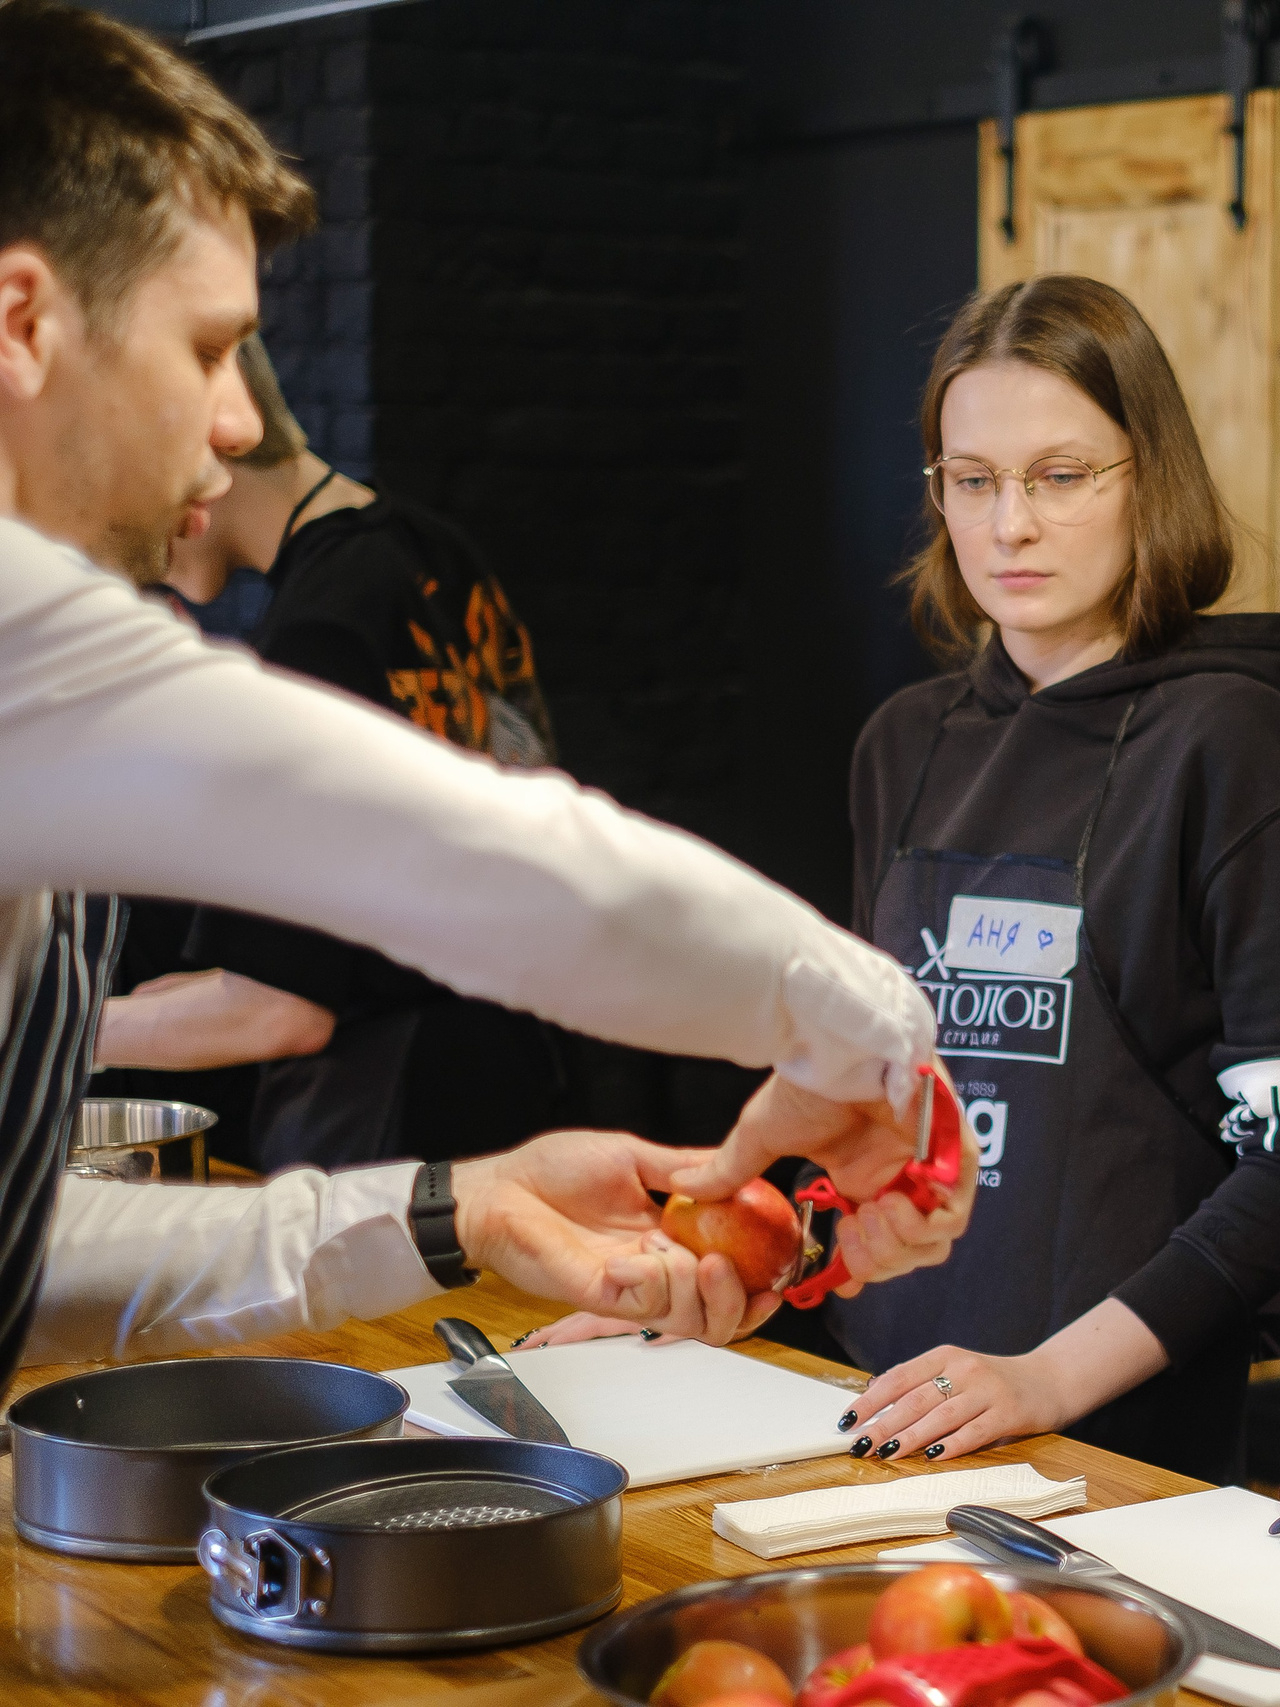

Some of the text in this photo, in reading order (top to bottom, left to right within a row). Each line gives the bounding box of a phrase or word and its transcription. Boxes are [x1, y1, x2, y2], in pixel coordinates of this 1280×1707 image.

[967, 914, 1022, 956] АНЯ
[916, 980, 1057, 1030] ТОЛОВ
[943, 1029, 1000, 1047] СТУДИЯ
